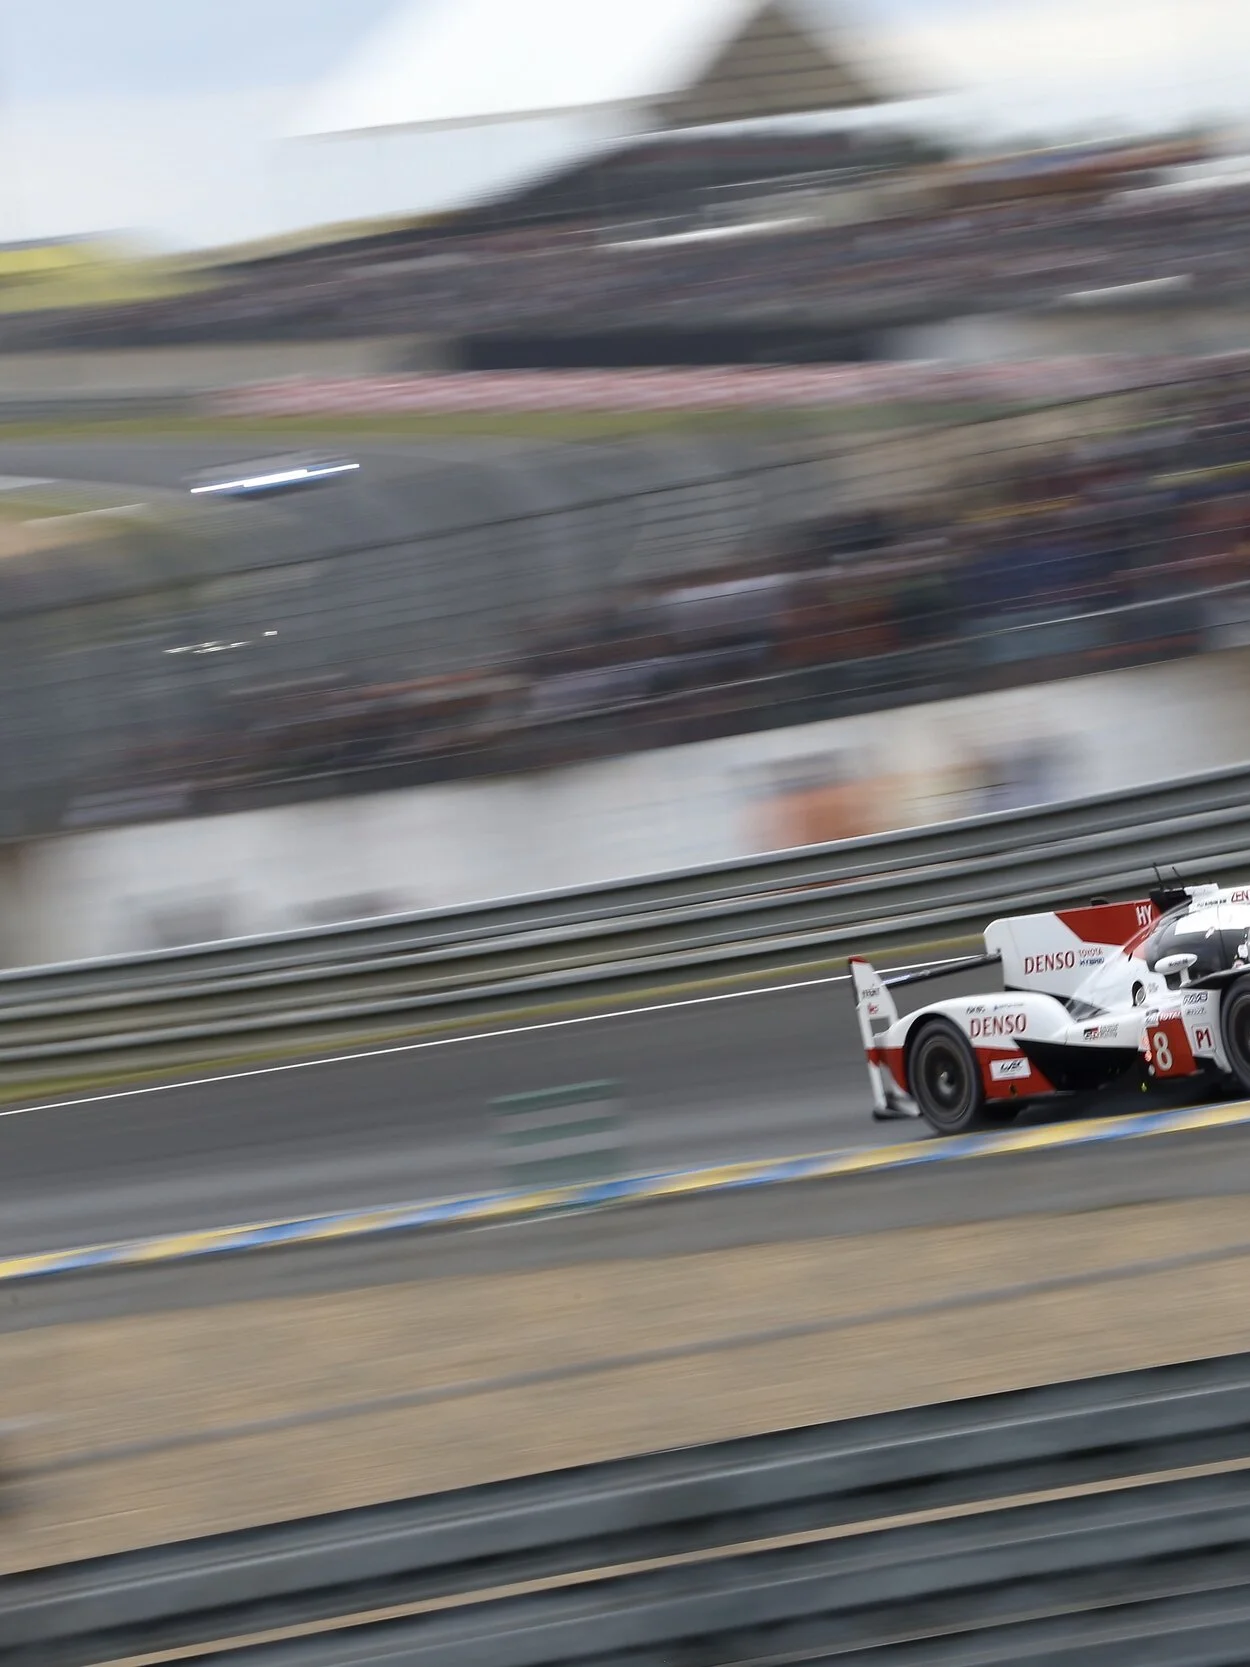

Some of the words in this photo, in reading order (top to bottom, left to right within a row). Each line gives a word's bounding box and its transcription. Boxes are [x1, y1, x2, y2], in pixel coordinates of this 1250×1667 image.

[1135, 904, 1153, 926] HY
[1024, 950, 1075, 975] DENSO
[970, 1013, 1027, 1038] DENSO
[1153, 1031, 1173, 1071] 8
[1196, 1028, 1212, 1049] P1
